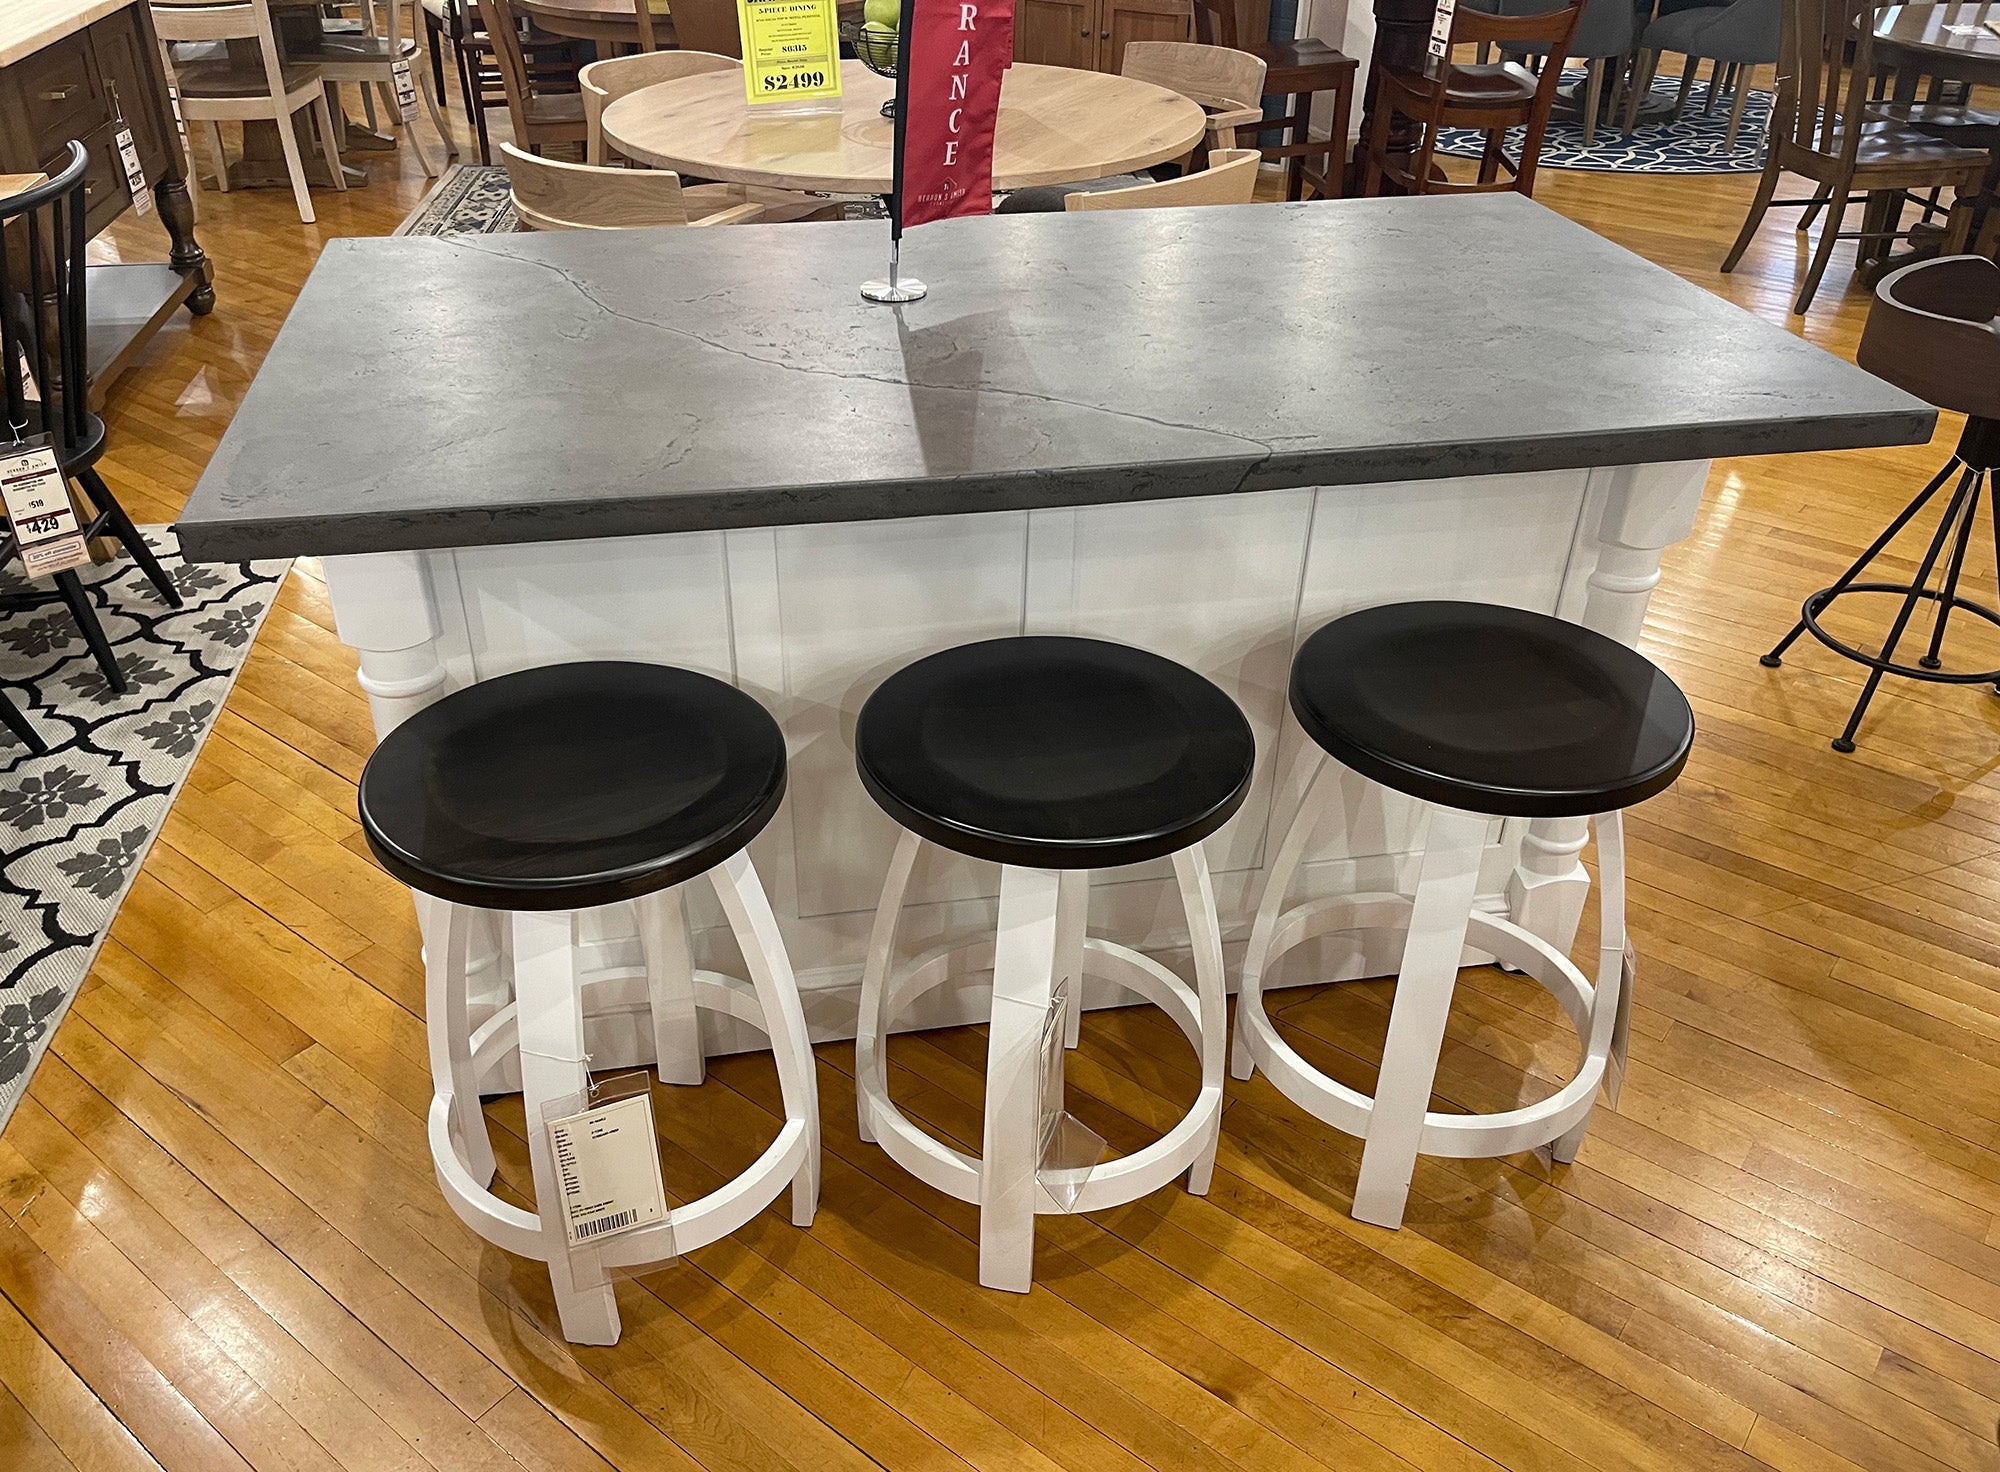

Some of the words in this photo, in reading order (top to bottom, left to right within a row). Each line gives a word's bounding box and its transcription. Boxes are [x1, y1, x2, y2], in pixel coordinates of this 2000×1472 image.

[789, 4, 817, 12] DINING
[764, 71, 824, 91] $2499
[25, 517, 59, 534] $429
